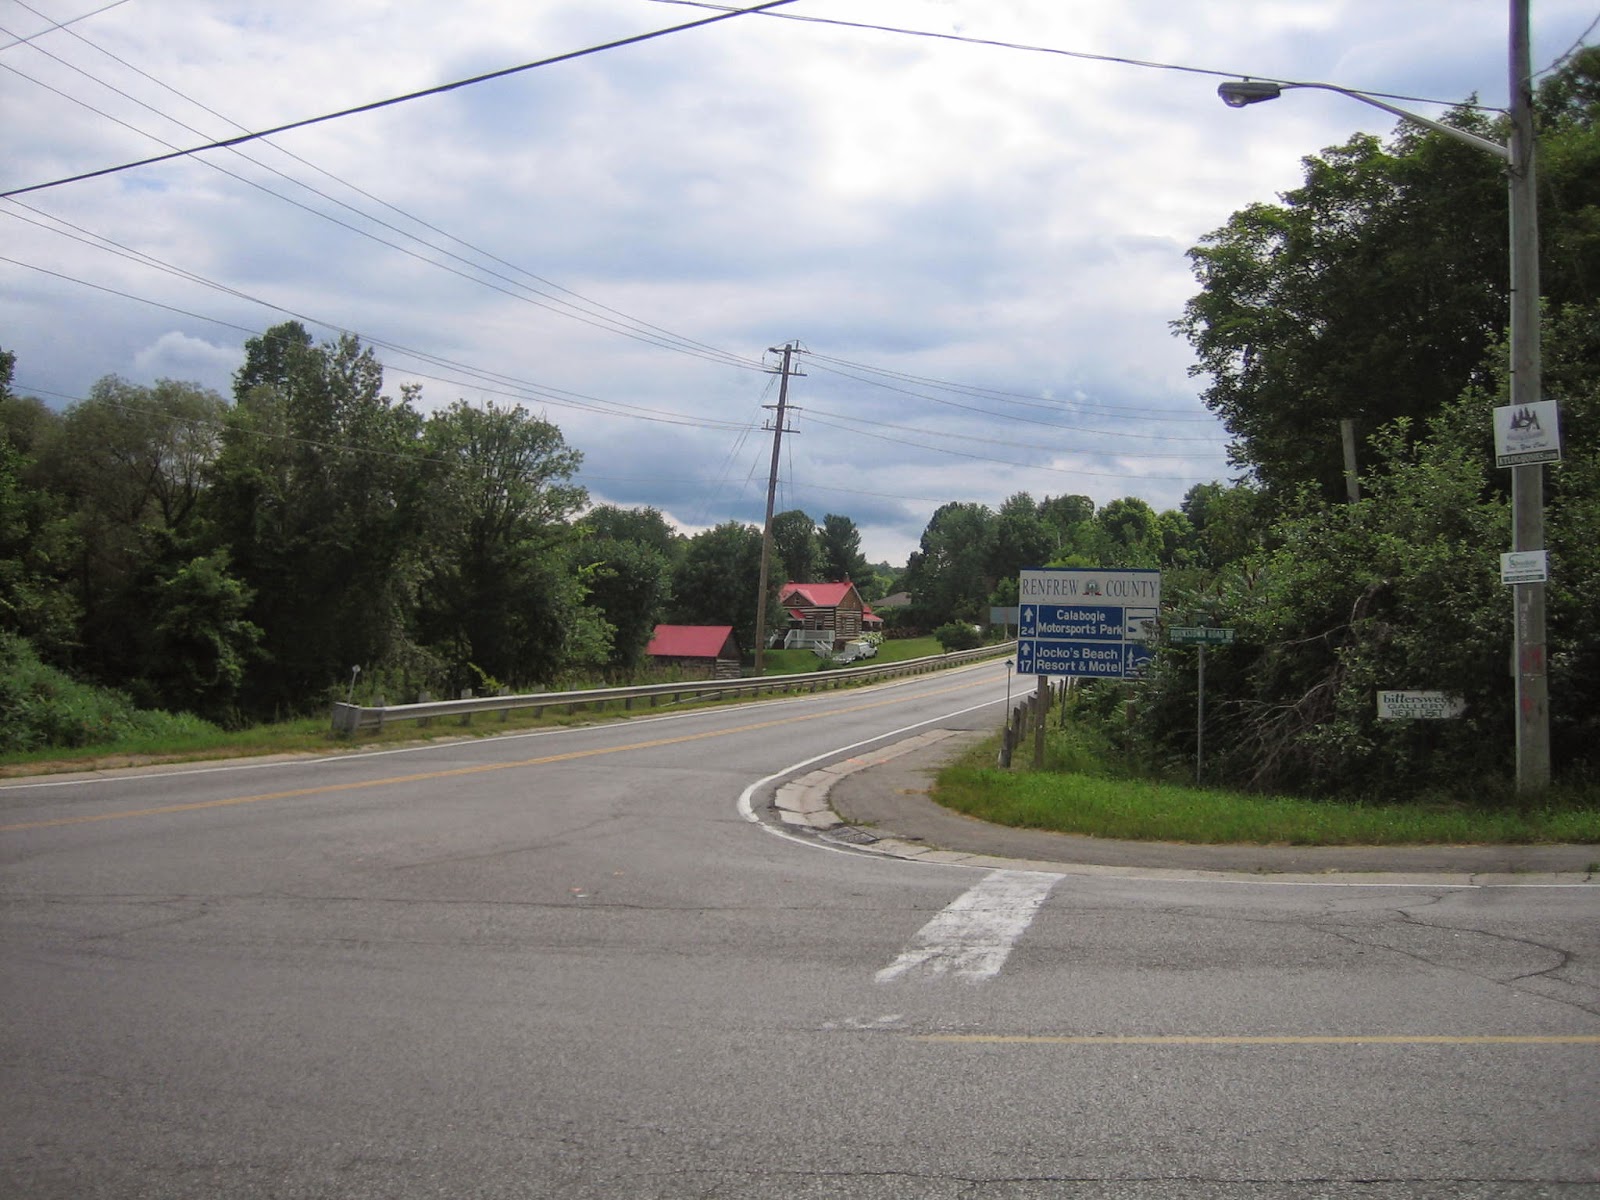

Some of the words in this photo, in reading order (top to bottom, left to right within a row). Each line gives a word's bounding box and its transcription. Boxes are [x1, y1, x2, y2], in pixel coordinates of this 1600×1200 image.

[1022, 579, 1079, 596] RENFREW
[1106, 580, 1158, 598] COUNTY
[1056, 609, 1106, 623] Calabogie
[1021, 626, 1035, 636] 24
[1038, 622, 1097, 636] Motorsports
[1099, 624, 1123, 636] Park
[1036, 647, 1080, 659] Jocko's
[1082, 648, 1118, 659] Beach
[1020, 660, 1032, 672] 17
[1036, 660, 1076, 671] Resort
[1079, 661, 1087, 672] &
[1088, 661, 1122, 673] Motel
